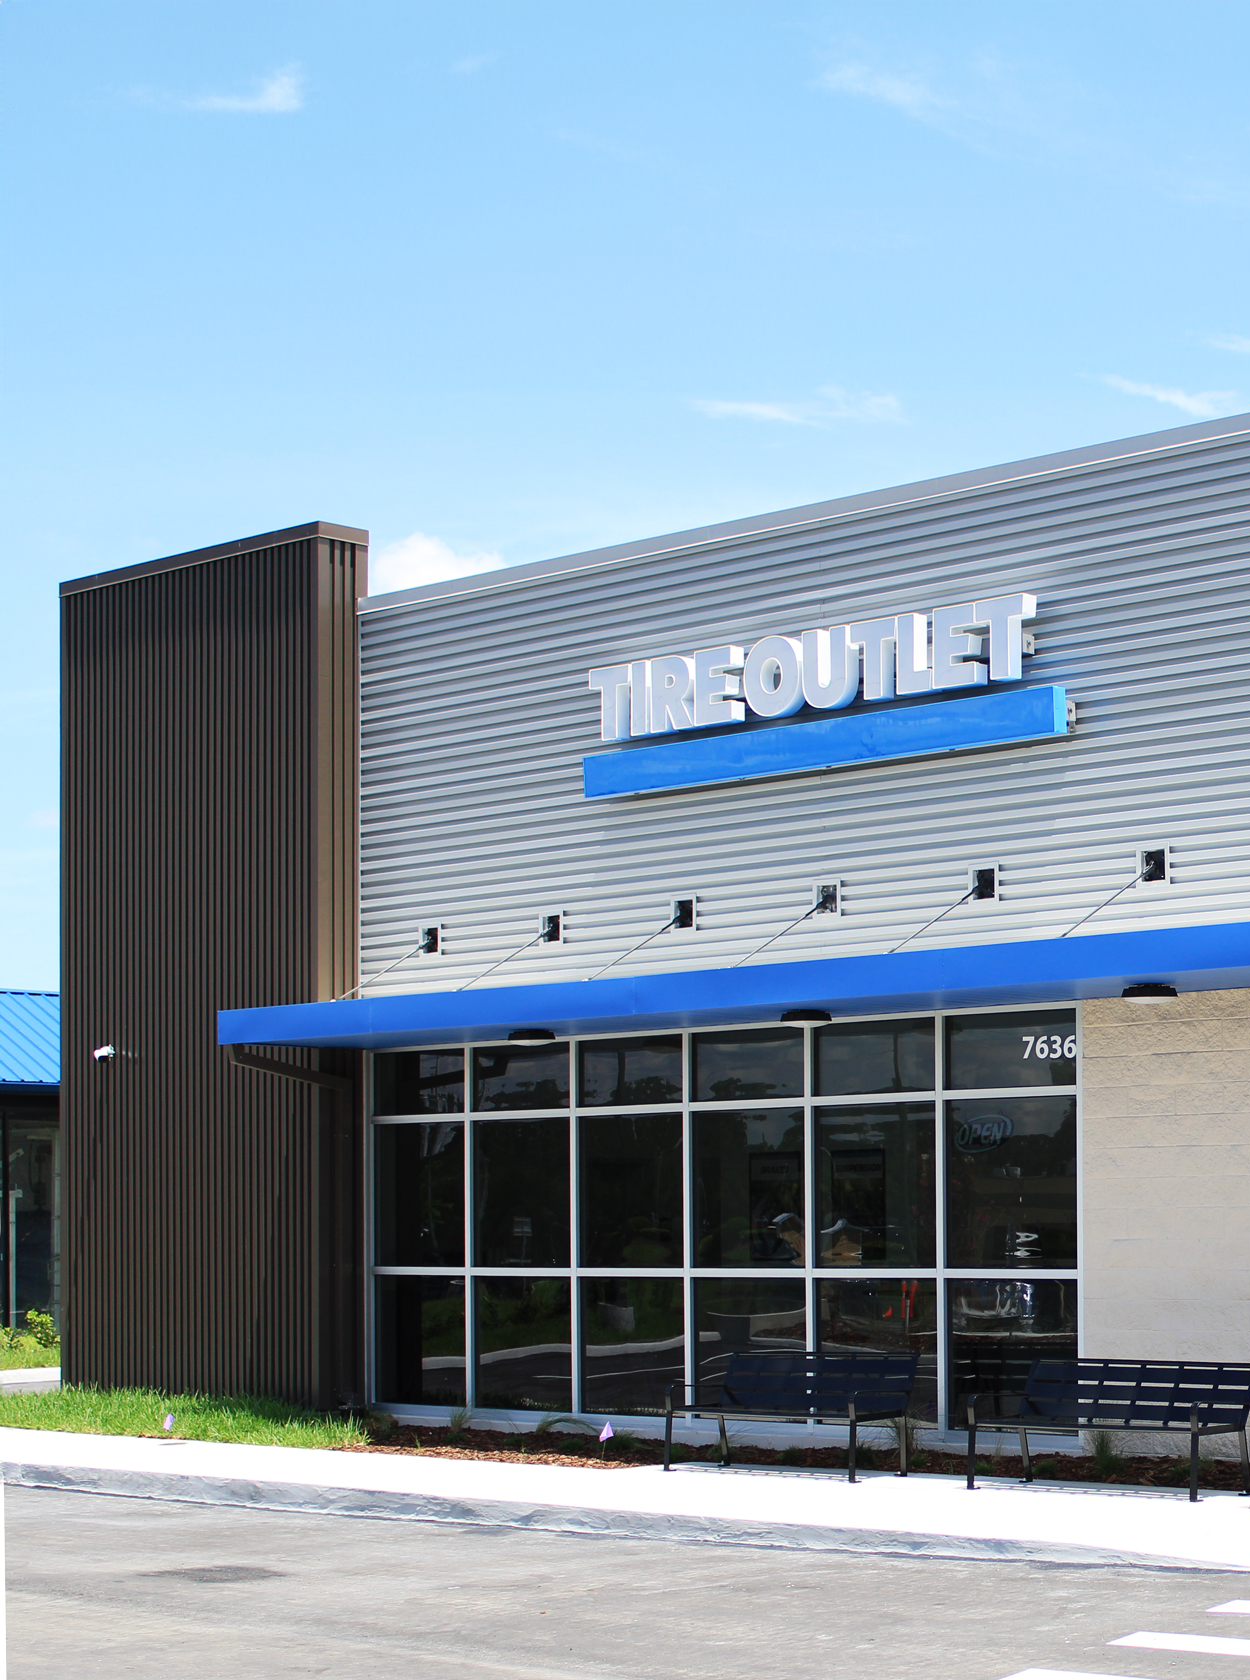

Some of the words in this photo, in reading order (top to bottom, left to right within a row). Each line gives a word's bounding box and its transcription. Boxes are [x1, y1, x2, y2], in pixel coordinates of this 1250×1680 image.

[1022, 1035, 1077, 1059] 7636
[958, 1121, 1005, 1146] OPEN
[760, 1165, 789, 1174] BRAKES
[835, 1164, 882, 1173] SUSPENSION
